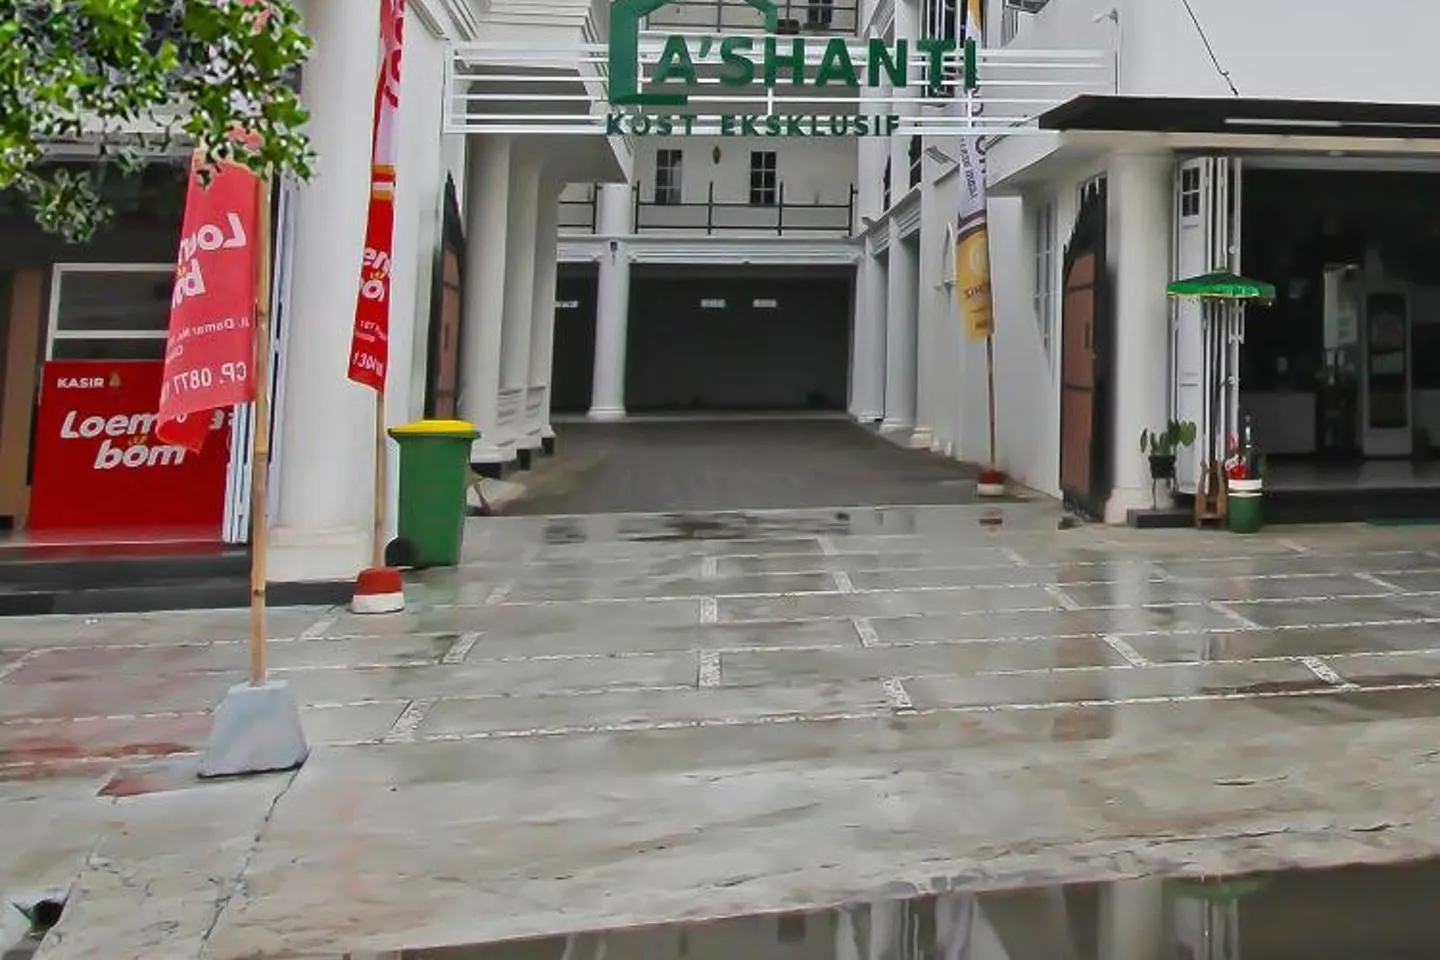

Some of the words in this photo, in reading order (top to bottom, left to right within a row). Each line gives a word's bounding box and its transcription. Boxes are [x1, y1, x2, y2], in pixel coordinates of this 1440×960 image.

[605, 113, 695, 137] KOST
[721, 113, 901, 137] EKSKLUSIF
[57, 377, 105, 389] KASIR
[94, 438, 187, 470] bom
